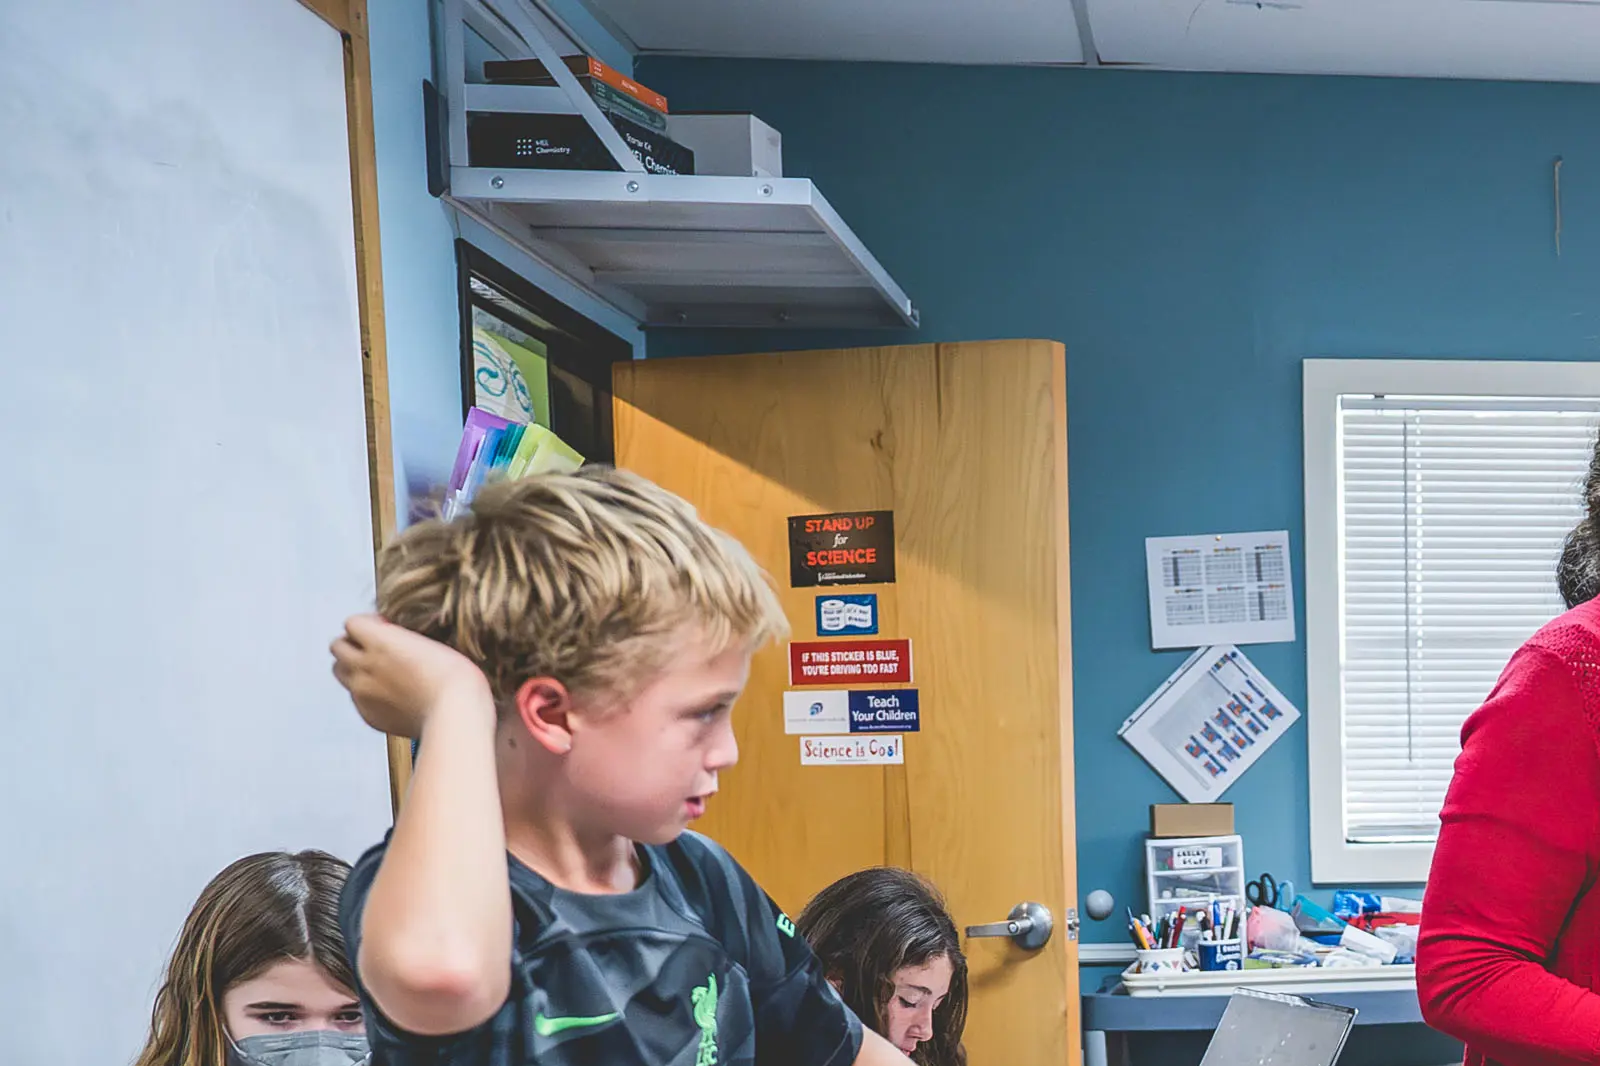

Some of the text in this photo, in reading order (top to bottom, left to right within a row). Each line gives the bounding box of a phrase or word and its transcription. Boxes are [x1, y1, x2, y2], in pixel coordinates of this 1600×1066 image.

[805, 516, 875, 533] STAND UP
[832, 533, 848, 548] for
[807, 548, 877, 566] SCIENCE
[802, 649, 900, 663] IF THIS STICKER IS BLUE,
[802, 662, 899, 676] YOU'RE DRIVING TOO FAST
[867, 695, 900, 709] Teach
[852, 709, 876, 723] Your
[876, 708, 917, 723] Children
[804, 739, 852, 758] Science
[855, 741, 865, 758] is
